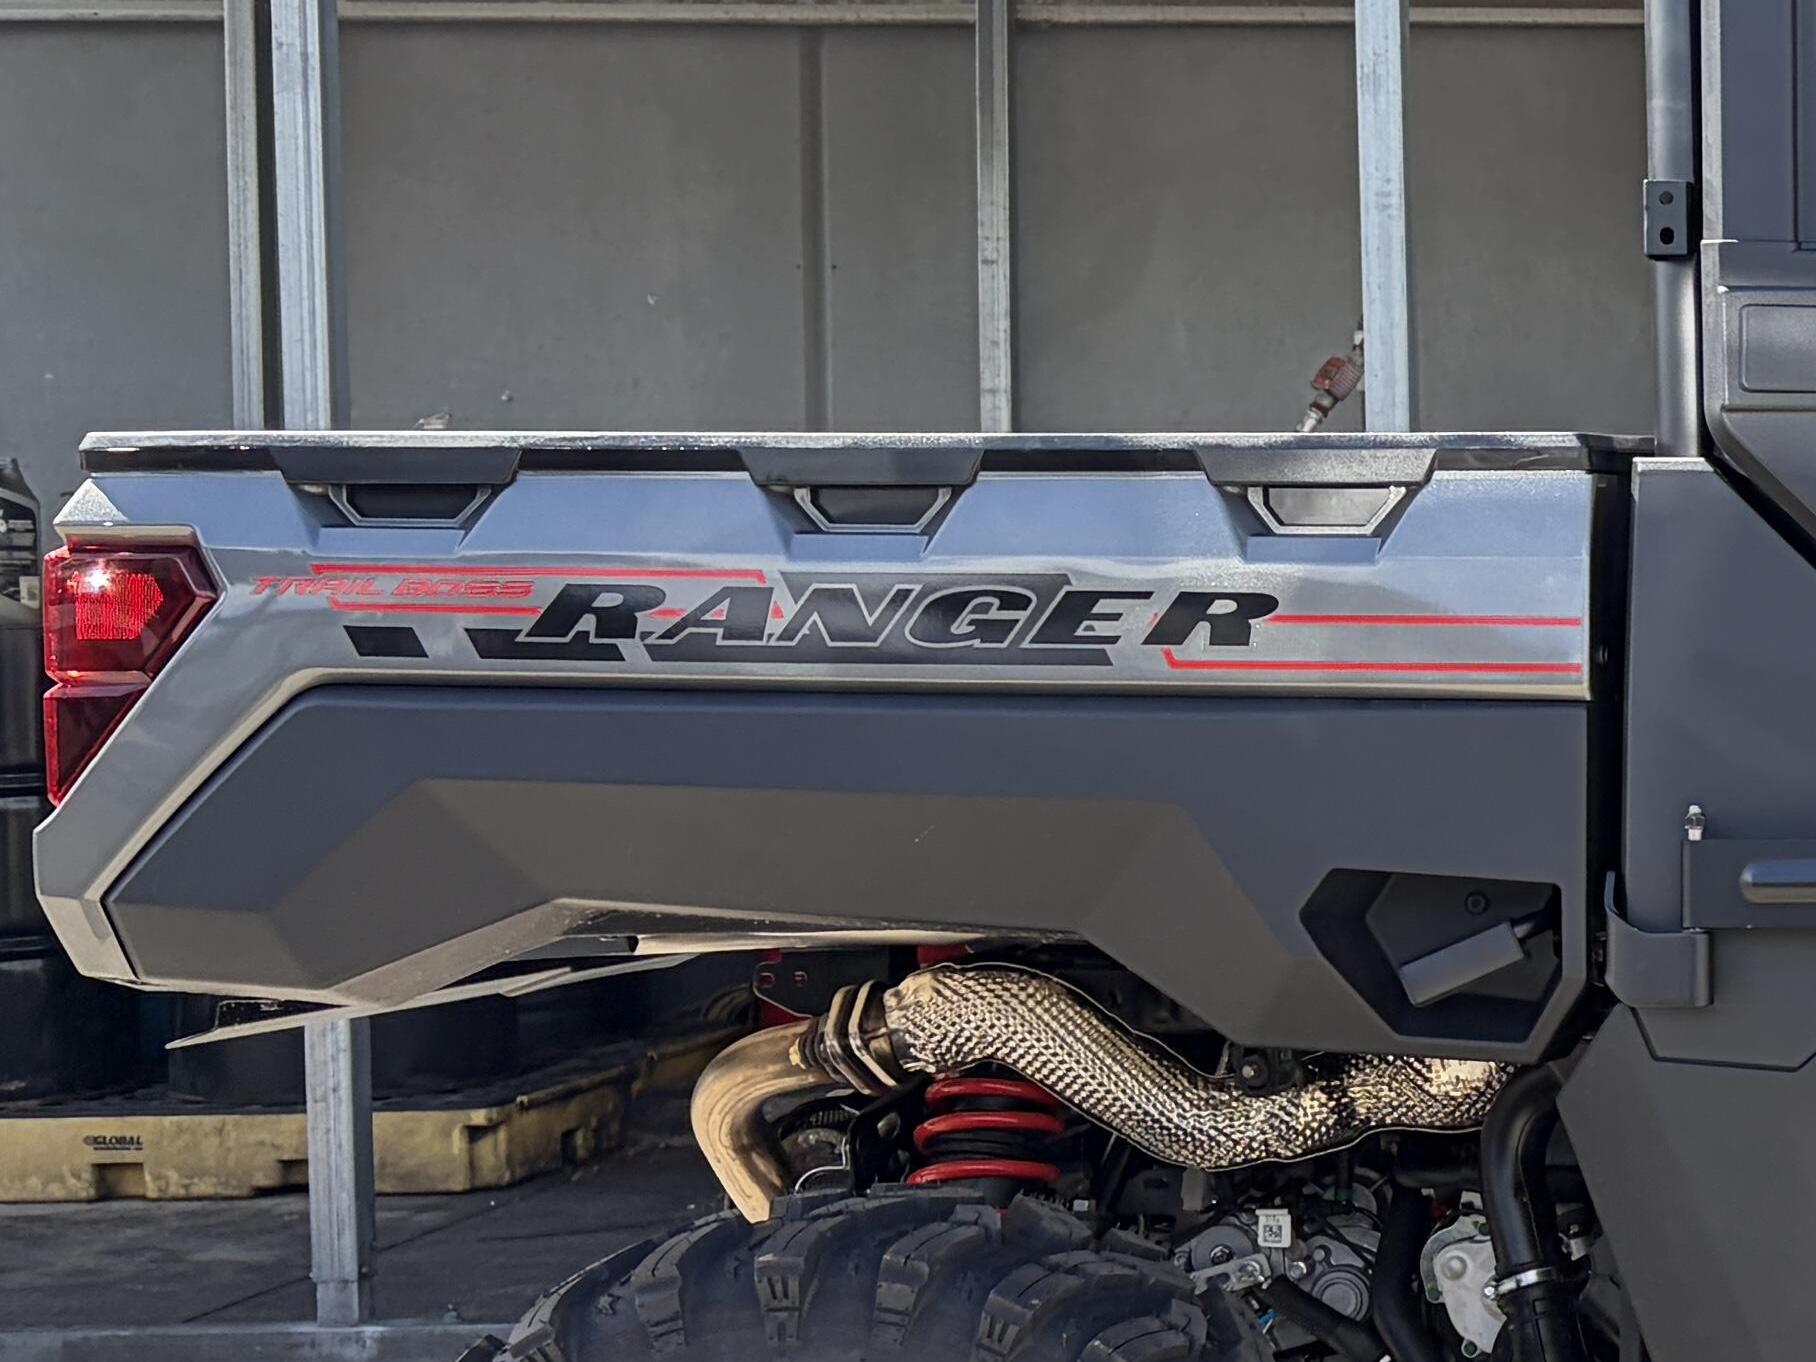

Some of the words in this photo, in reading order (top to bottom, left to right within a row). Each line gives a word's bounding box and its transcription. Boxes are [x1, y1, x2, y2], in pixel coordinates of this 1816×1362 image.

[253, 576, 384, 597] TRAIL
[392, 578, 535, 599] BOSS
[520, 583, 1280, 650] RANGER
